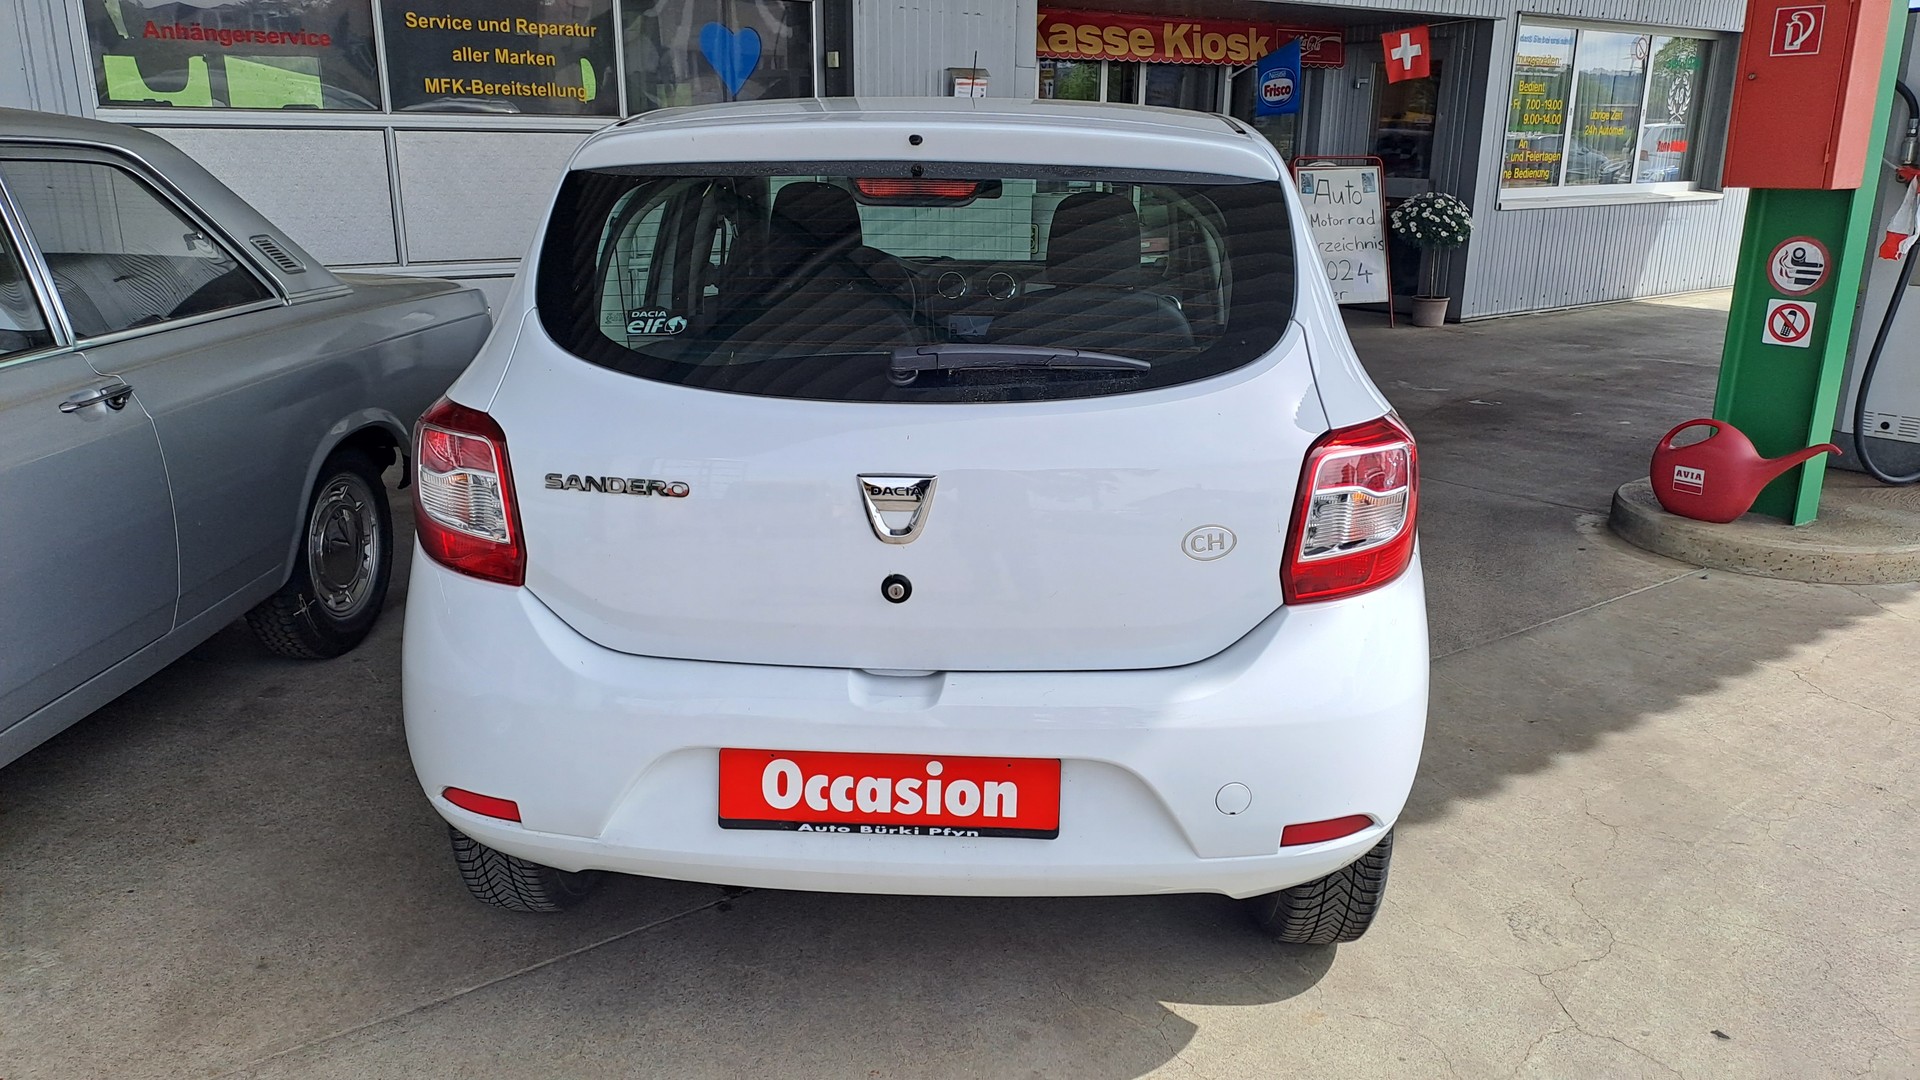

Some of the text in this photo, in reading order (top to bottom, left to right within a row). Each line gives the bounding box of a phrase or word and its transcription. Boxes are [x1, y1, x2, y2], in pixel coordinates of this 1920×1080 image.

[143, 20, 331, 47] Anhängerservice
[405, 12, 597, 38] Service und Reparatur
[1163, 22, 1271, 62] Kiosk
[452, 46, 556, 66] aller Marken
[424, 78, 588, 103] MFK-Bereitstellung
[1264, 83, 1292, 98] Frisco
[1519, 138, 1529, 149] An
[1510, 150, 1561, 164] und Feiertagen
[1513, 167, 1550, 180] Bedienung
[1313, 178, 1363, 206] Auto
[1310, 209, 1376, 229] Motorrad
[631, 310, 667, 318] DACIA
[627, 318, 666, 334] elf
[1676, 469, 1702, 481] AVIA
[544, 472, 690, 498] SANDERO
[870, 484, 924, 498] DACIA
[1191, 533, 1225, 552] CH
[762, 758, 1019, 819] Occasion
[797, 822, 981, 838] Auto Bürki Pfyn
